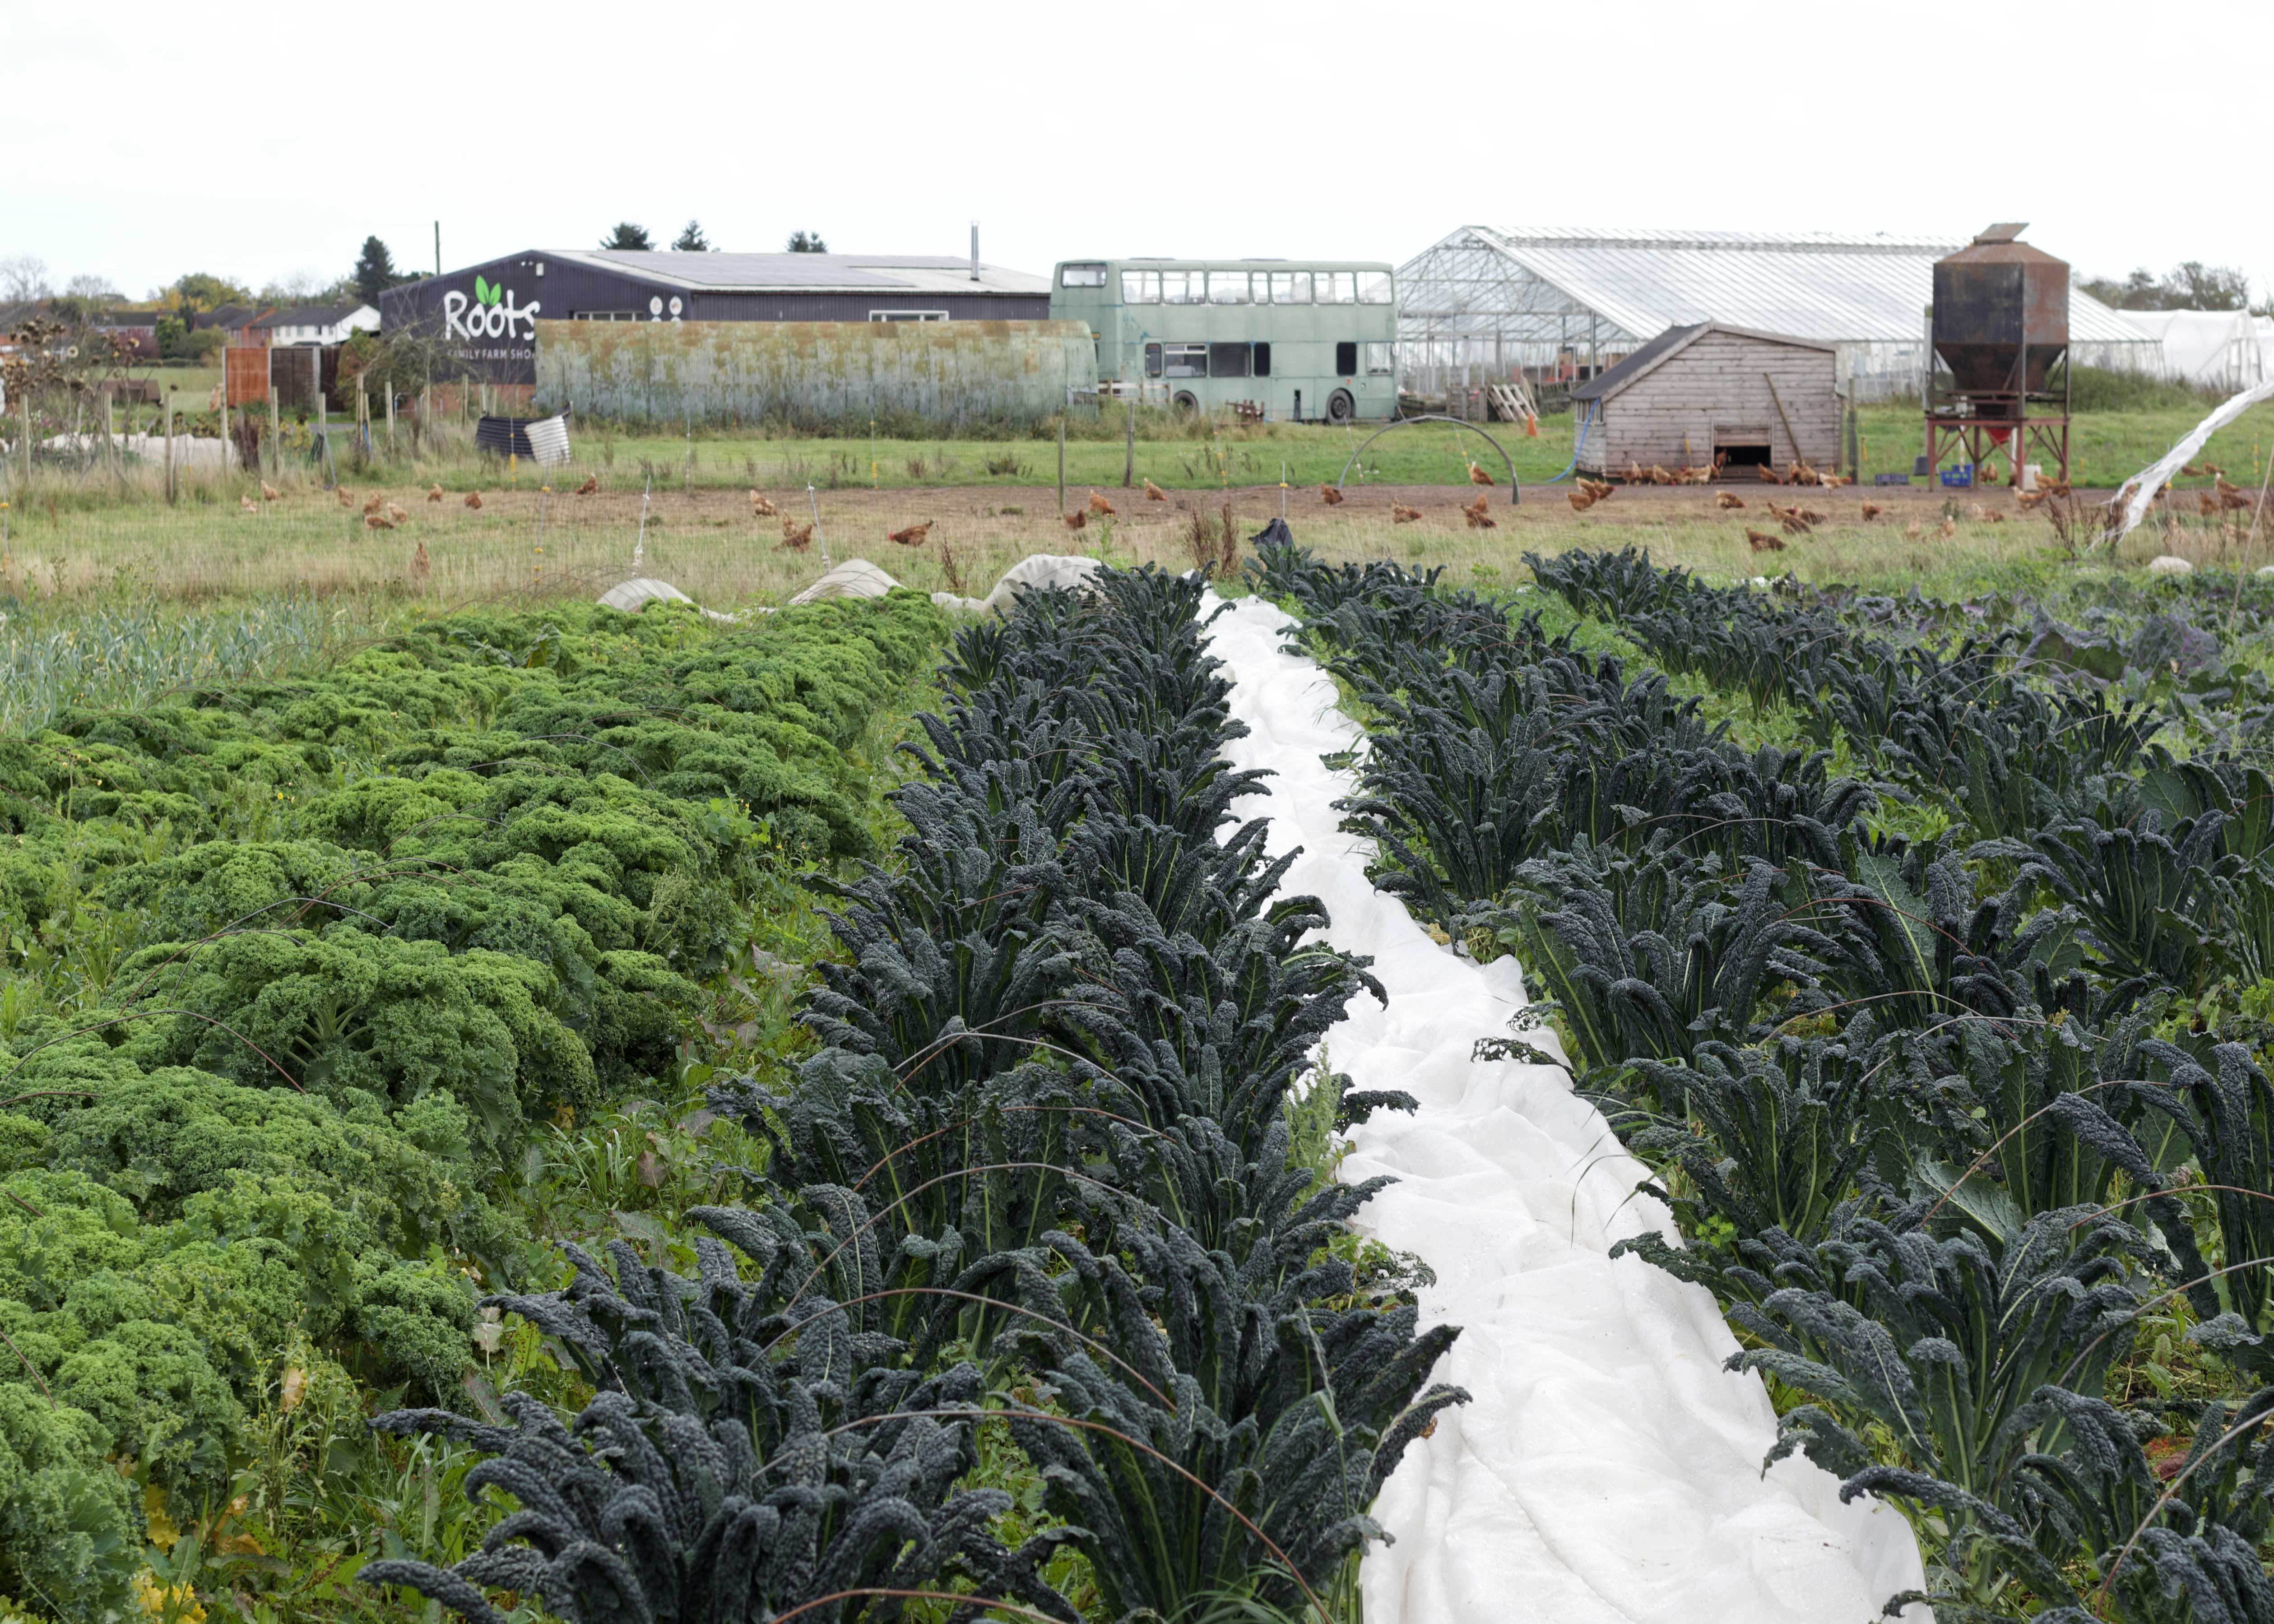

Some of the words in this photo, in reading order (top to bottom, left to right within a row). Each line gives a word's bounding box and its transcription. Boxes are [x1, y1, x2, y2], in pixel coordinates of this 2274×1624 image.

[444, 289, 540, 341] Roots
[482, 348, 507, 359] FARM
[510, 348, 534, 359] SHO
